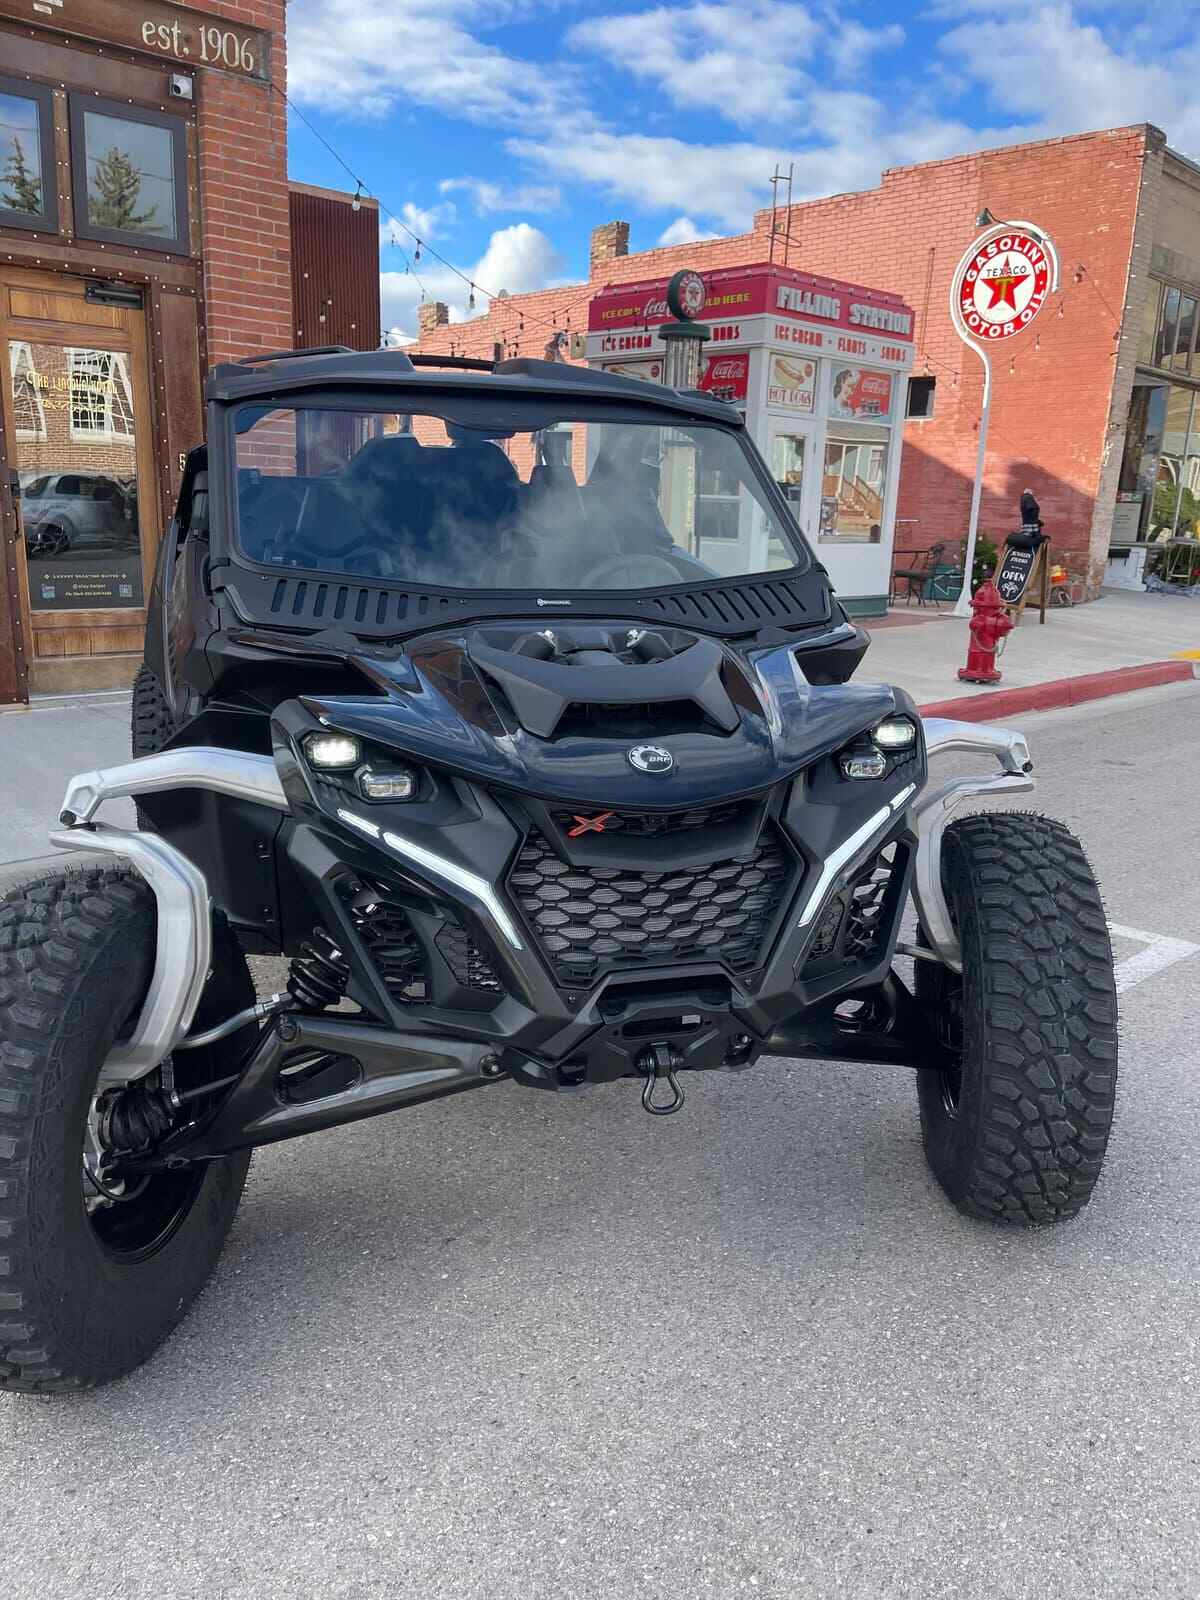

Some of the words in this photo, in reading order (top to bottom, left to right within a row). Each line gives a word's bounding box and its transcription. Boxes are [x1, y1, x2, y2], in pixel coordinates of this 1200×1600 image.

[142, 20, 190, 58] est.
[199, 25, 254, 72] 1906
[966, 238, 1047, 282] GASOLINE
[986, 265, 1027, 277] TEXACO
[602, 310, 617, 320] ICE
[723, 293, 751, 304] HERE
[776, 286, 840, 320] FILLING
[848, 303, 911, 335] STATION
[962, 298, 1015, 337] MOTOR
[1020, 290, 1046, 323] OIL
[602, 337, 616, 352] ICE
[619, 335, 652, 350] CREAM
[775, 325, 790, 341] ICE
[792, 328, 823, 347] CREAM
[838, 337, 866, 355] FLOATS
[712, 360, 745, 380] Coca-Cola
[768, 387, 788, 402] HOT
[1002, 570, 1026, 582] OPEN
